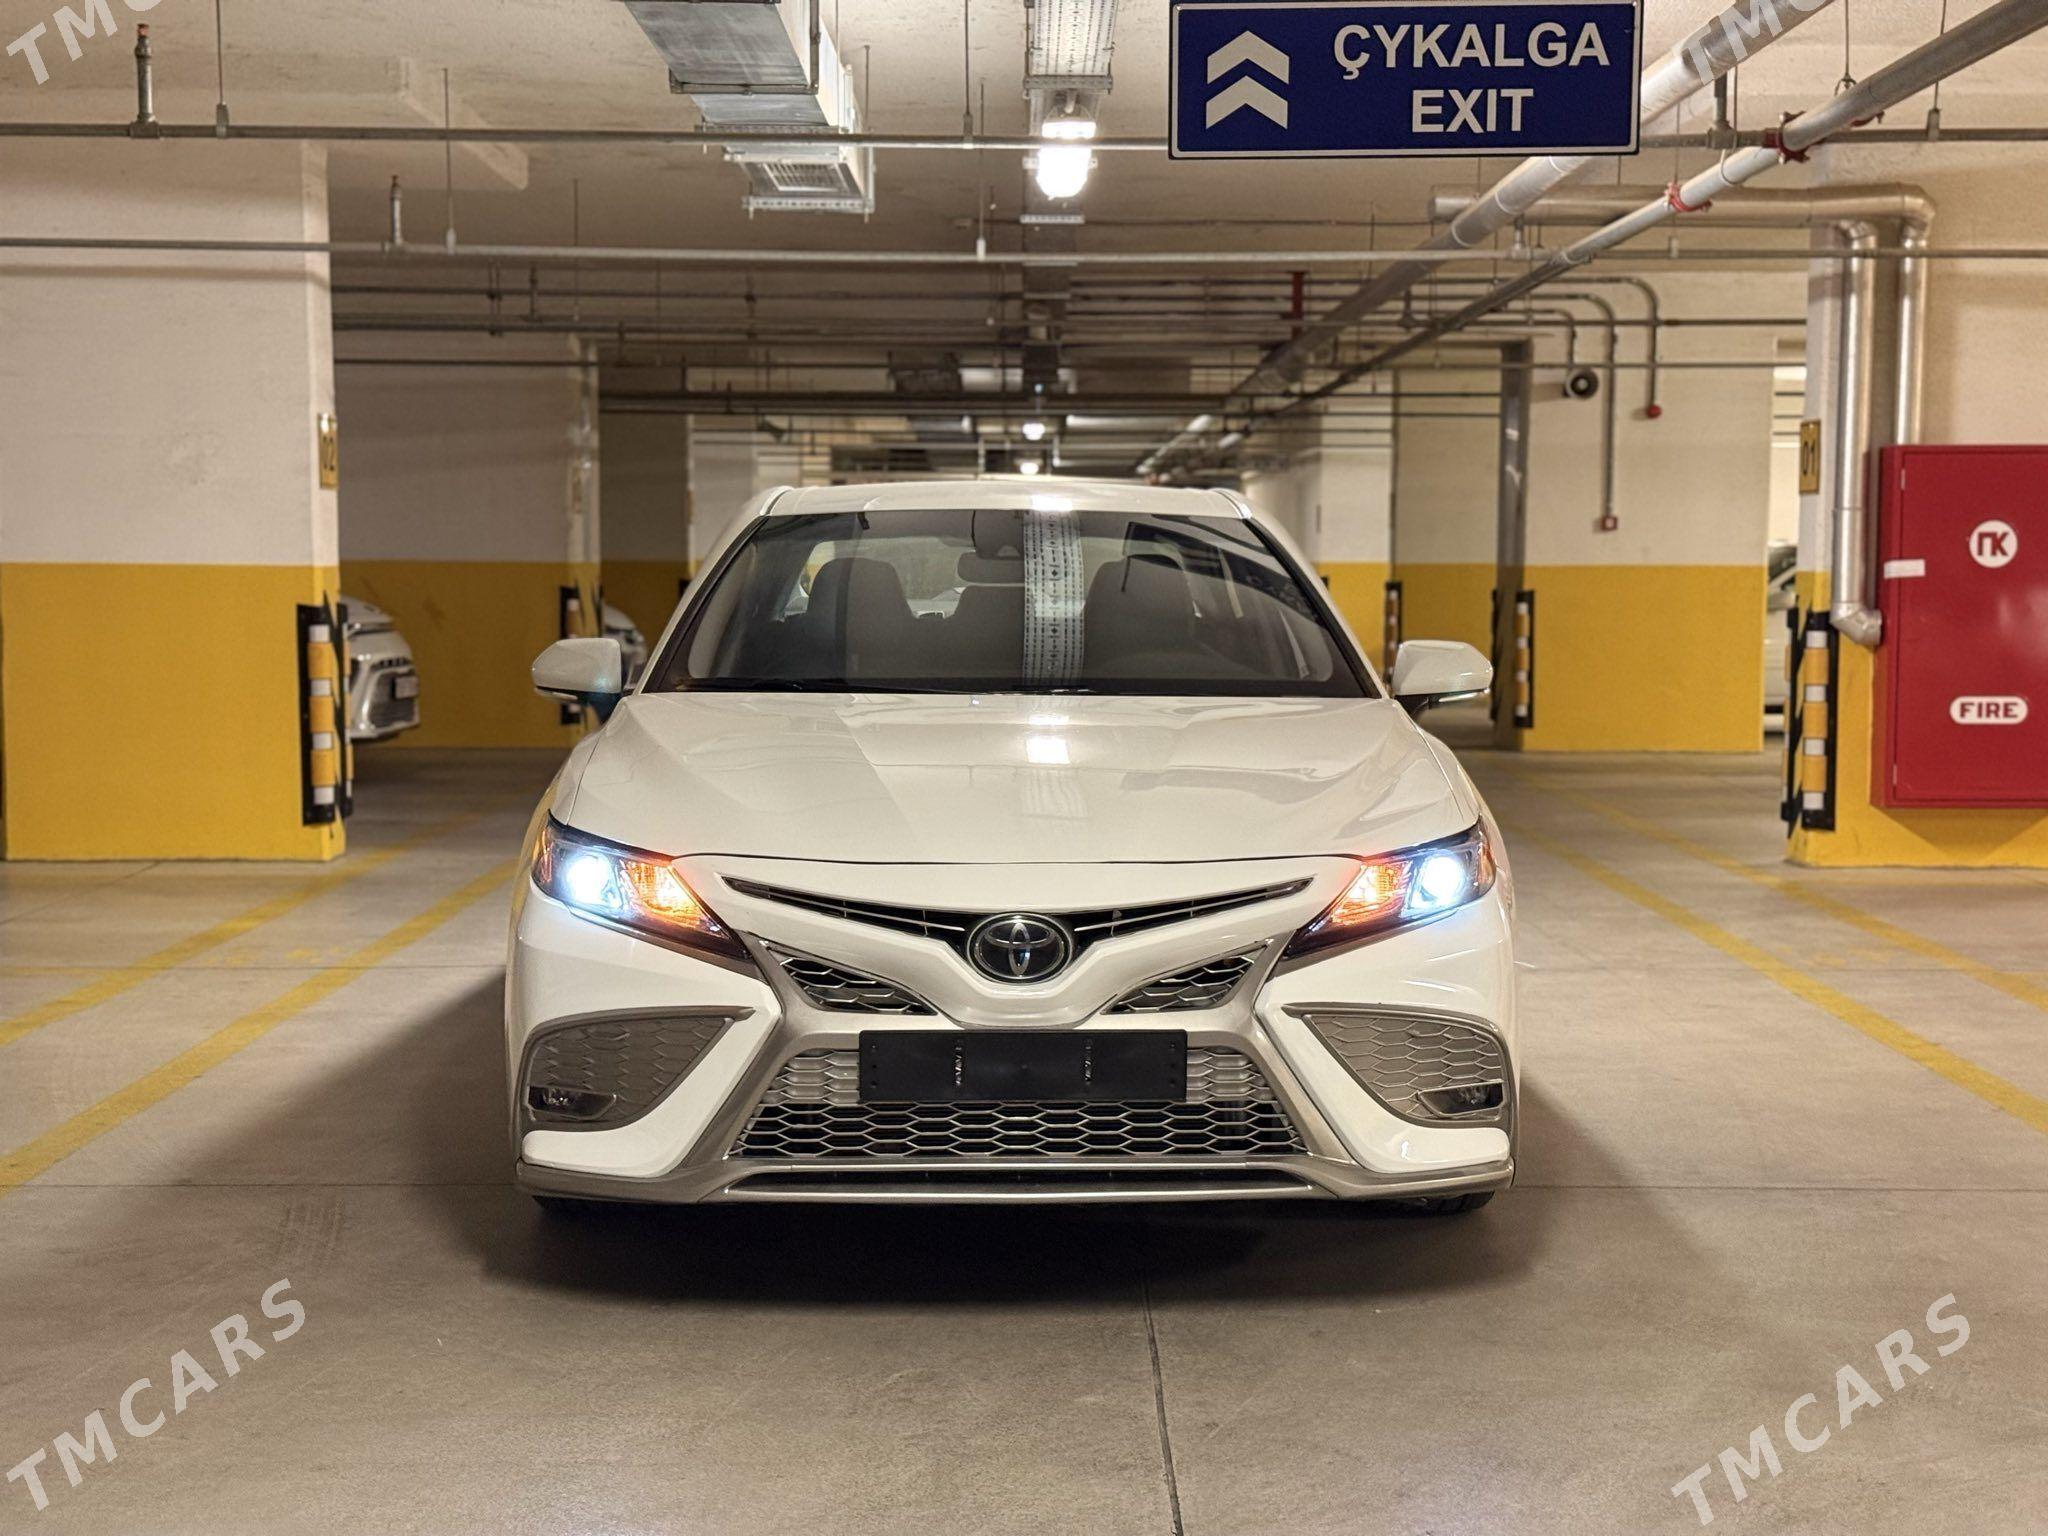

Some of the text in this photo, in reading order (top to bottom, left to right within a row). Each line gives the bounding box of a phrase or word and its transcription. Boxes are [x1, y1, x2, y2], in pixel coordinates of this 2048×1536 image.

[1333, 22, 1611, 80] ÇYKALGA
[1411, 88, 1535, 134] EXIT
[1802, 440, 1817, 476] 01
[1958, 702, 2019, 719] FIRE
